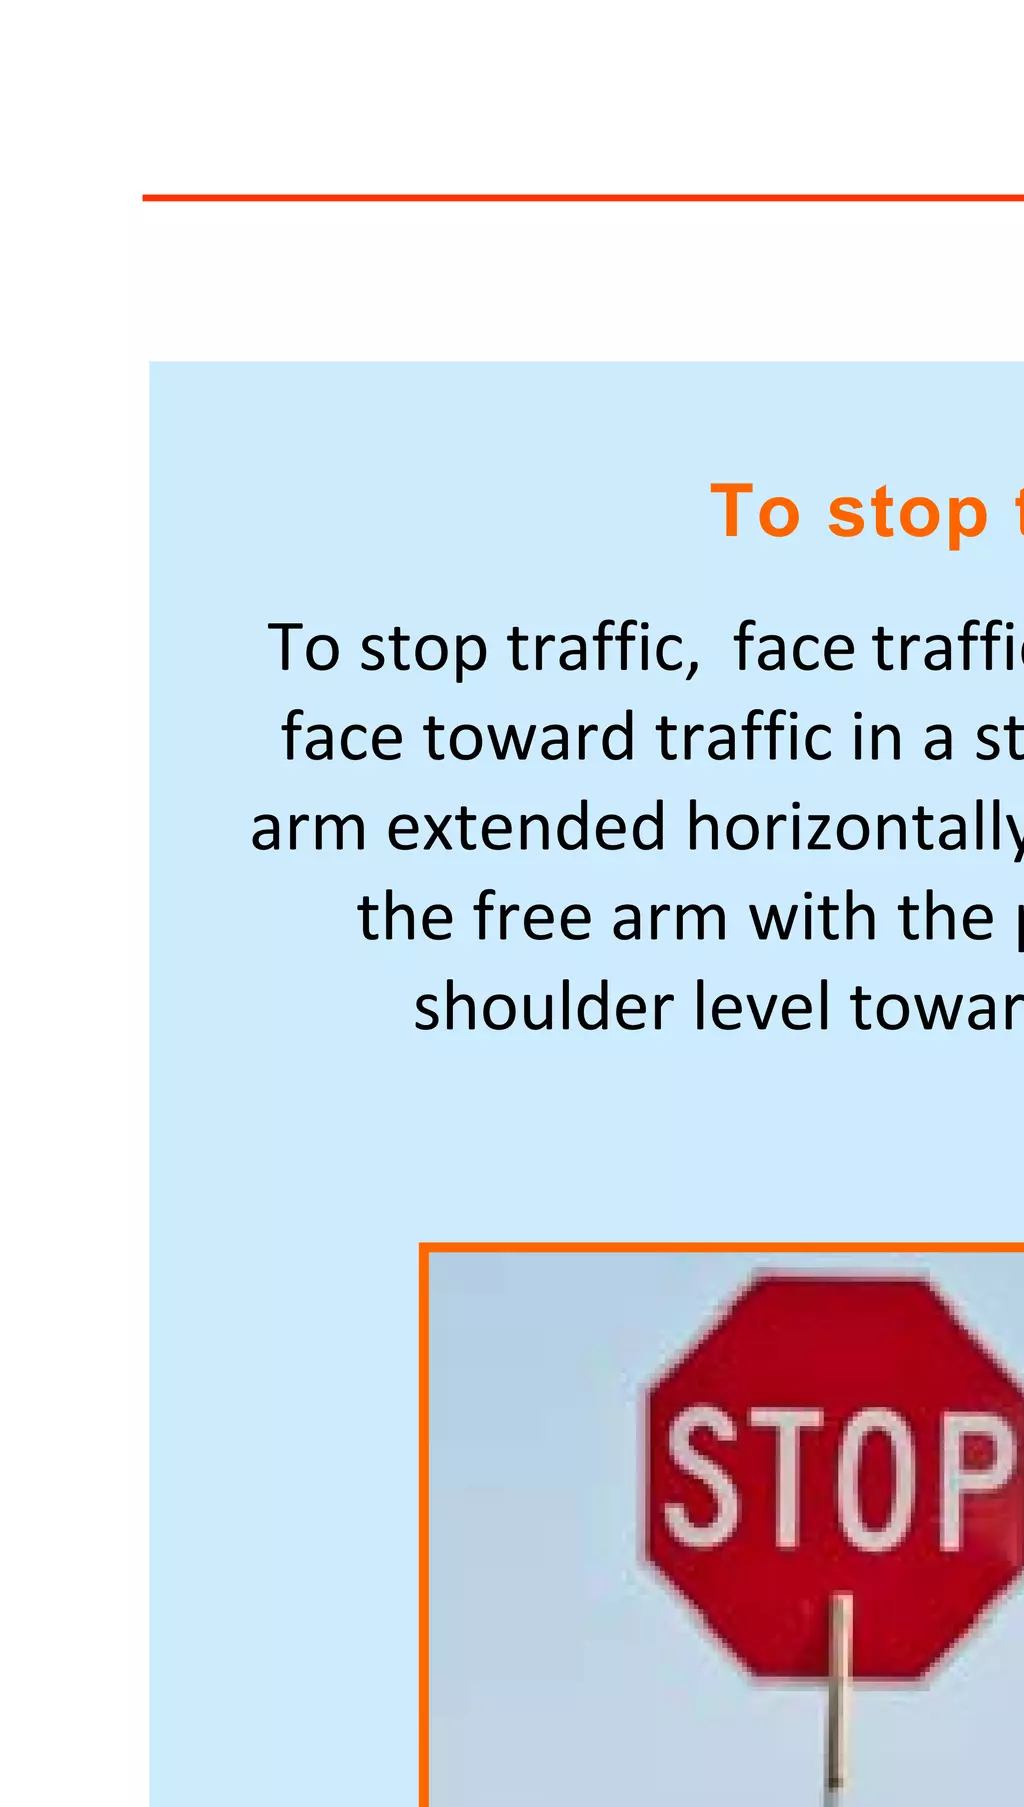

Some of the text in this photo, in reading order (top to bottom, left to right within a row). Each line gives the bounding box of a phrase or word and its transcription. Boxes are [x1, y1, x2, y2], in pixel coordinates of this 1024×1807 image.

[709, 483, 800, 538] To
[827, 483, 988, 552] stop
[267, 622, 340, 672] To
[360, 626, 487, 684] stop
[506, 618, 699, 681] traffic,
[732, 618, 855, 672] face
[280, 708, 403, 761] face
[422, 708, 634, 761] toward
[654, 708, 832, 761] traffic
[853, 710, 901, 761] in
[924, 723, 953, 761] a
[251, 813, 365, 851] arm
[387, 798, 664, 851] extended
[356, 888, 454, 941] the
[472, 888, 592, 941] free
[612, 903, 726, 941] arm
[748, 888, 876, 941] with
[897, 888, 994, 941] the
[414, 978, 675, 1031] shoulder
[696, 978, 828, 1031] level
[662, 1403, 1020, 1554] STOP
